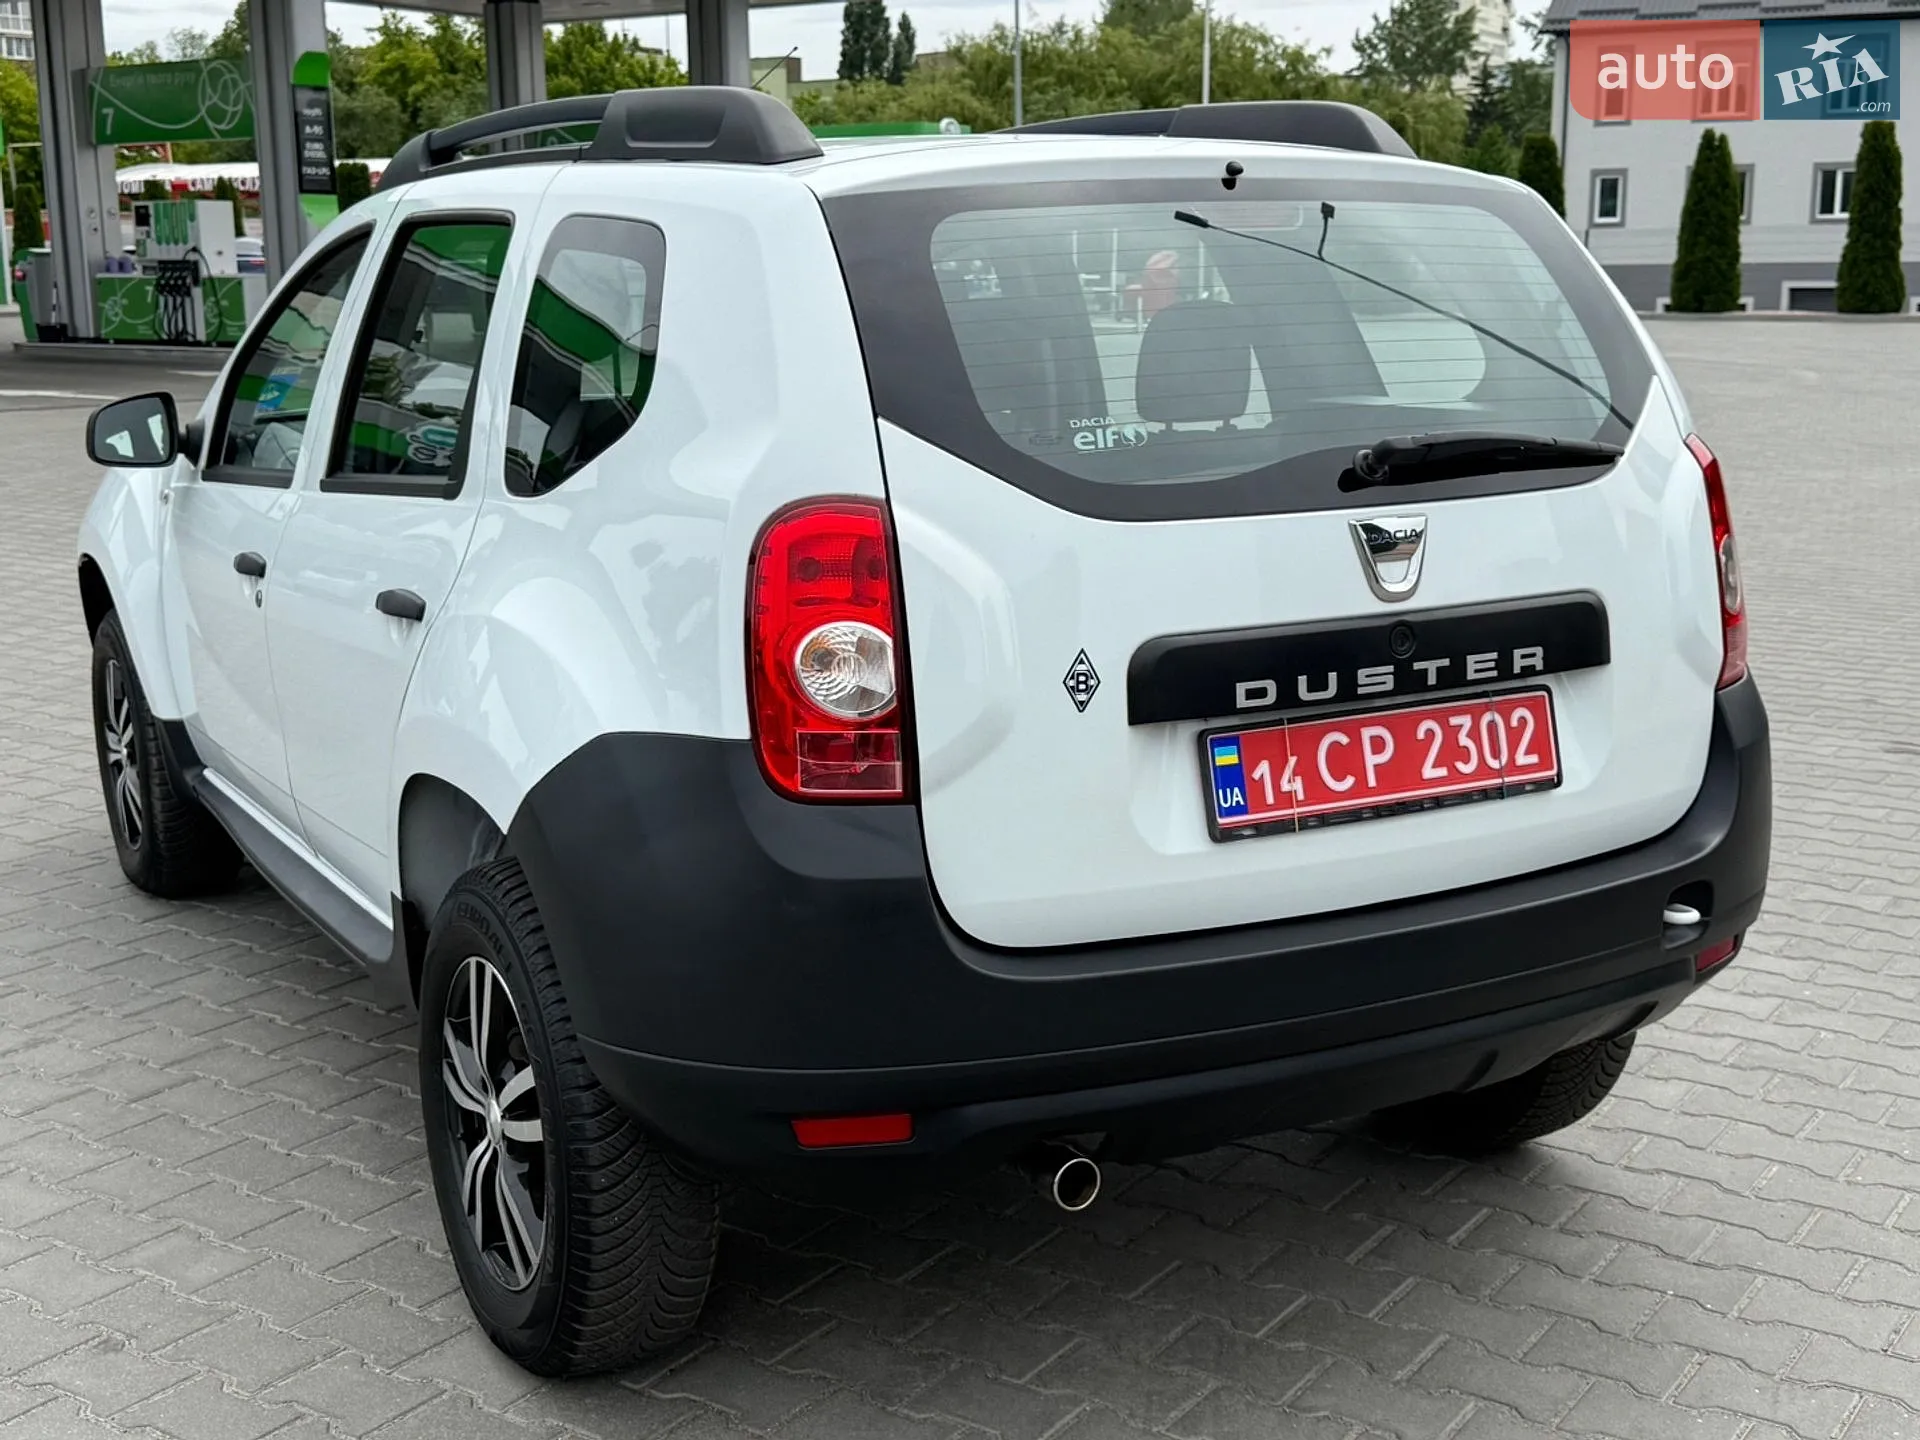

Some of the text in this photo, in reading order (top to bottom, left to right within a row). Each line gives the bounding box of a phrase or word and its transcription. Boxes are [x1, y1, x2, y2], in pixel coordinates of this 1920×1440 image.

[101, 107, 115, 136] 7
[144, 284, 154, 304] 7
[1069, 416, 1117, 428] DACIA
[1073, 427, 1119, 451] elf
[1368, 528, 1419, 545] DACIA
[1075, 671, 1091, 694] B
[1235, 645, 1545, 709] DUSTER
[1252, 706, 1540, 805] 14 CP 2302
[1218, 786, 1245, 808] UA
